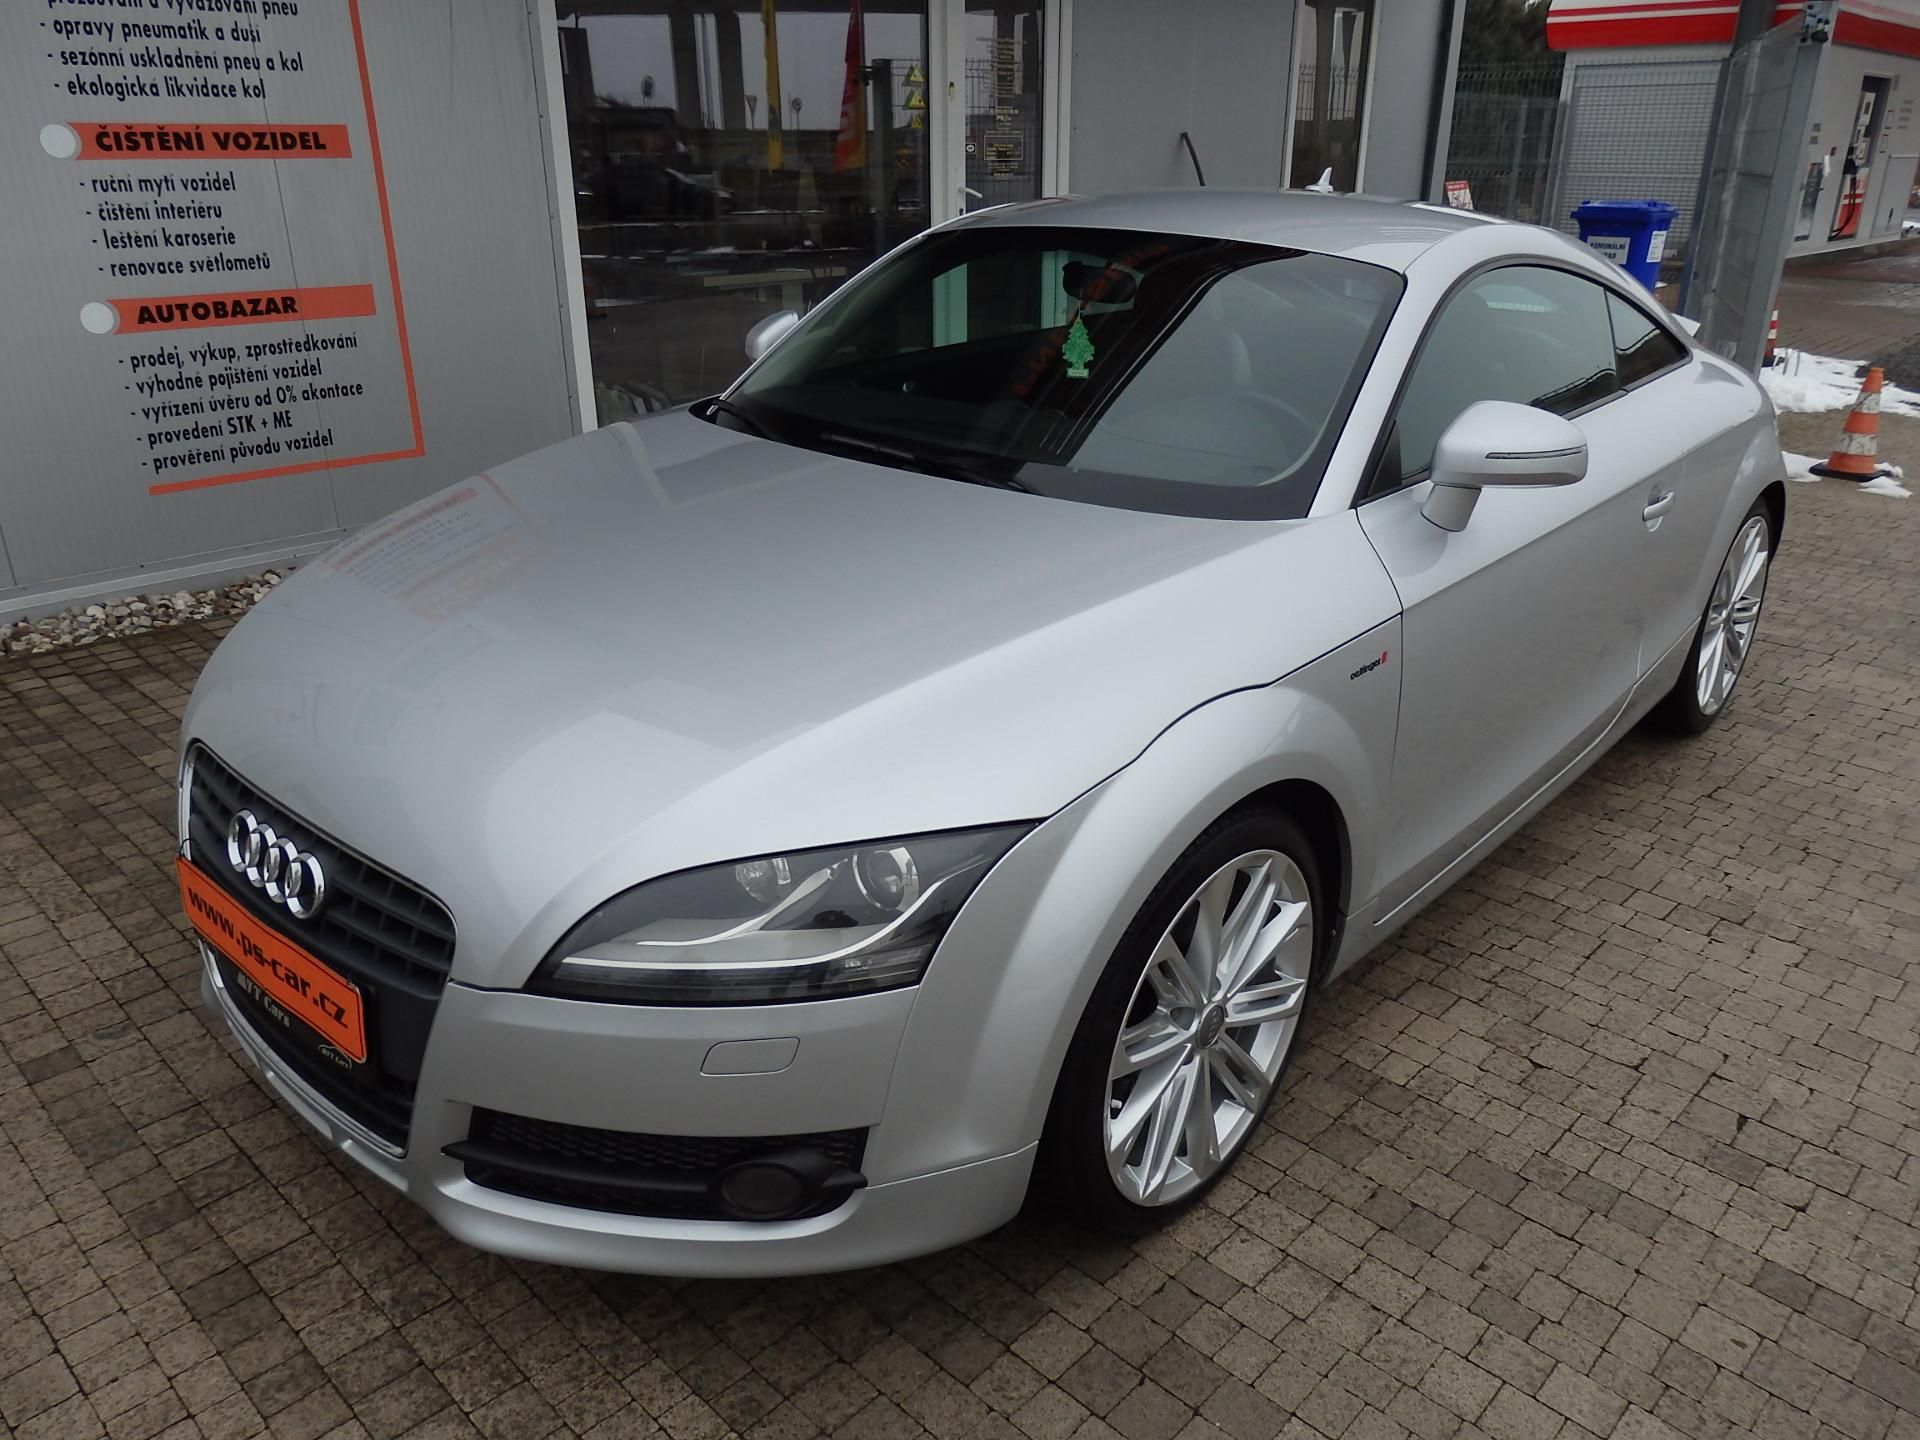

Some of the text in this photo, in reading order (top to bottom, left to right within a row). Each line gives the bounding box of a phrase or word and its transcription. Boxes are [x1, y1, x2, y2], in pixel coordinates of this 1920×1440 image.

[262, 0, 298, 19] pneu
[53, 19, 261, 42] opravy pneumatik a duší
[60, 46, 304, 75] sezónní uskladnění pneu a kol
[67, 73, 266, 101] ekologická likvidace kol
[95, 124, 327, 152] ČIŠTĚNÍ VOZIDEL
[92, 174, 133, 192] ruční
[181, 170, 237, 191] vozidel
[98, 199, 223, 221] čištění interiéru
[103, 226, 237, 249] leštění karoserie
[110, 251, 271, 277] renovace světlometů
[137, 296, 299, 325] AUTOBAZAR
[130, 331, 358, 374] prodej, výkup, zprostředkování
[136, 357, 322, 399] výhodné pojištění vozidel
[141, 397, 205, 424] vyřízení
[255, 387, 272, 407] od
[276, 384, 297, 404] 0%
[301, 382, 363, 401] akontace
[147, 410, 293, 450] provedení STK + ME
[153, 428, 334, 475] prověření původu vozidel
